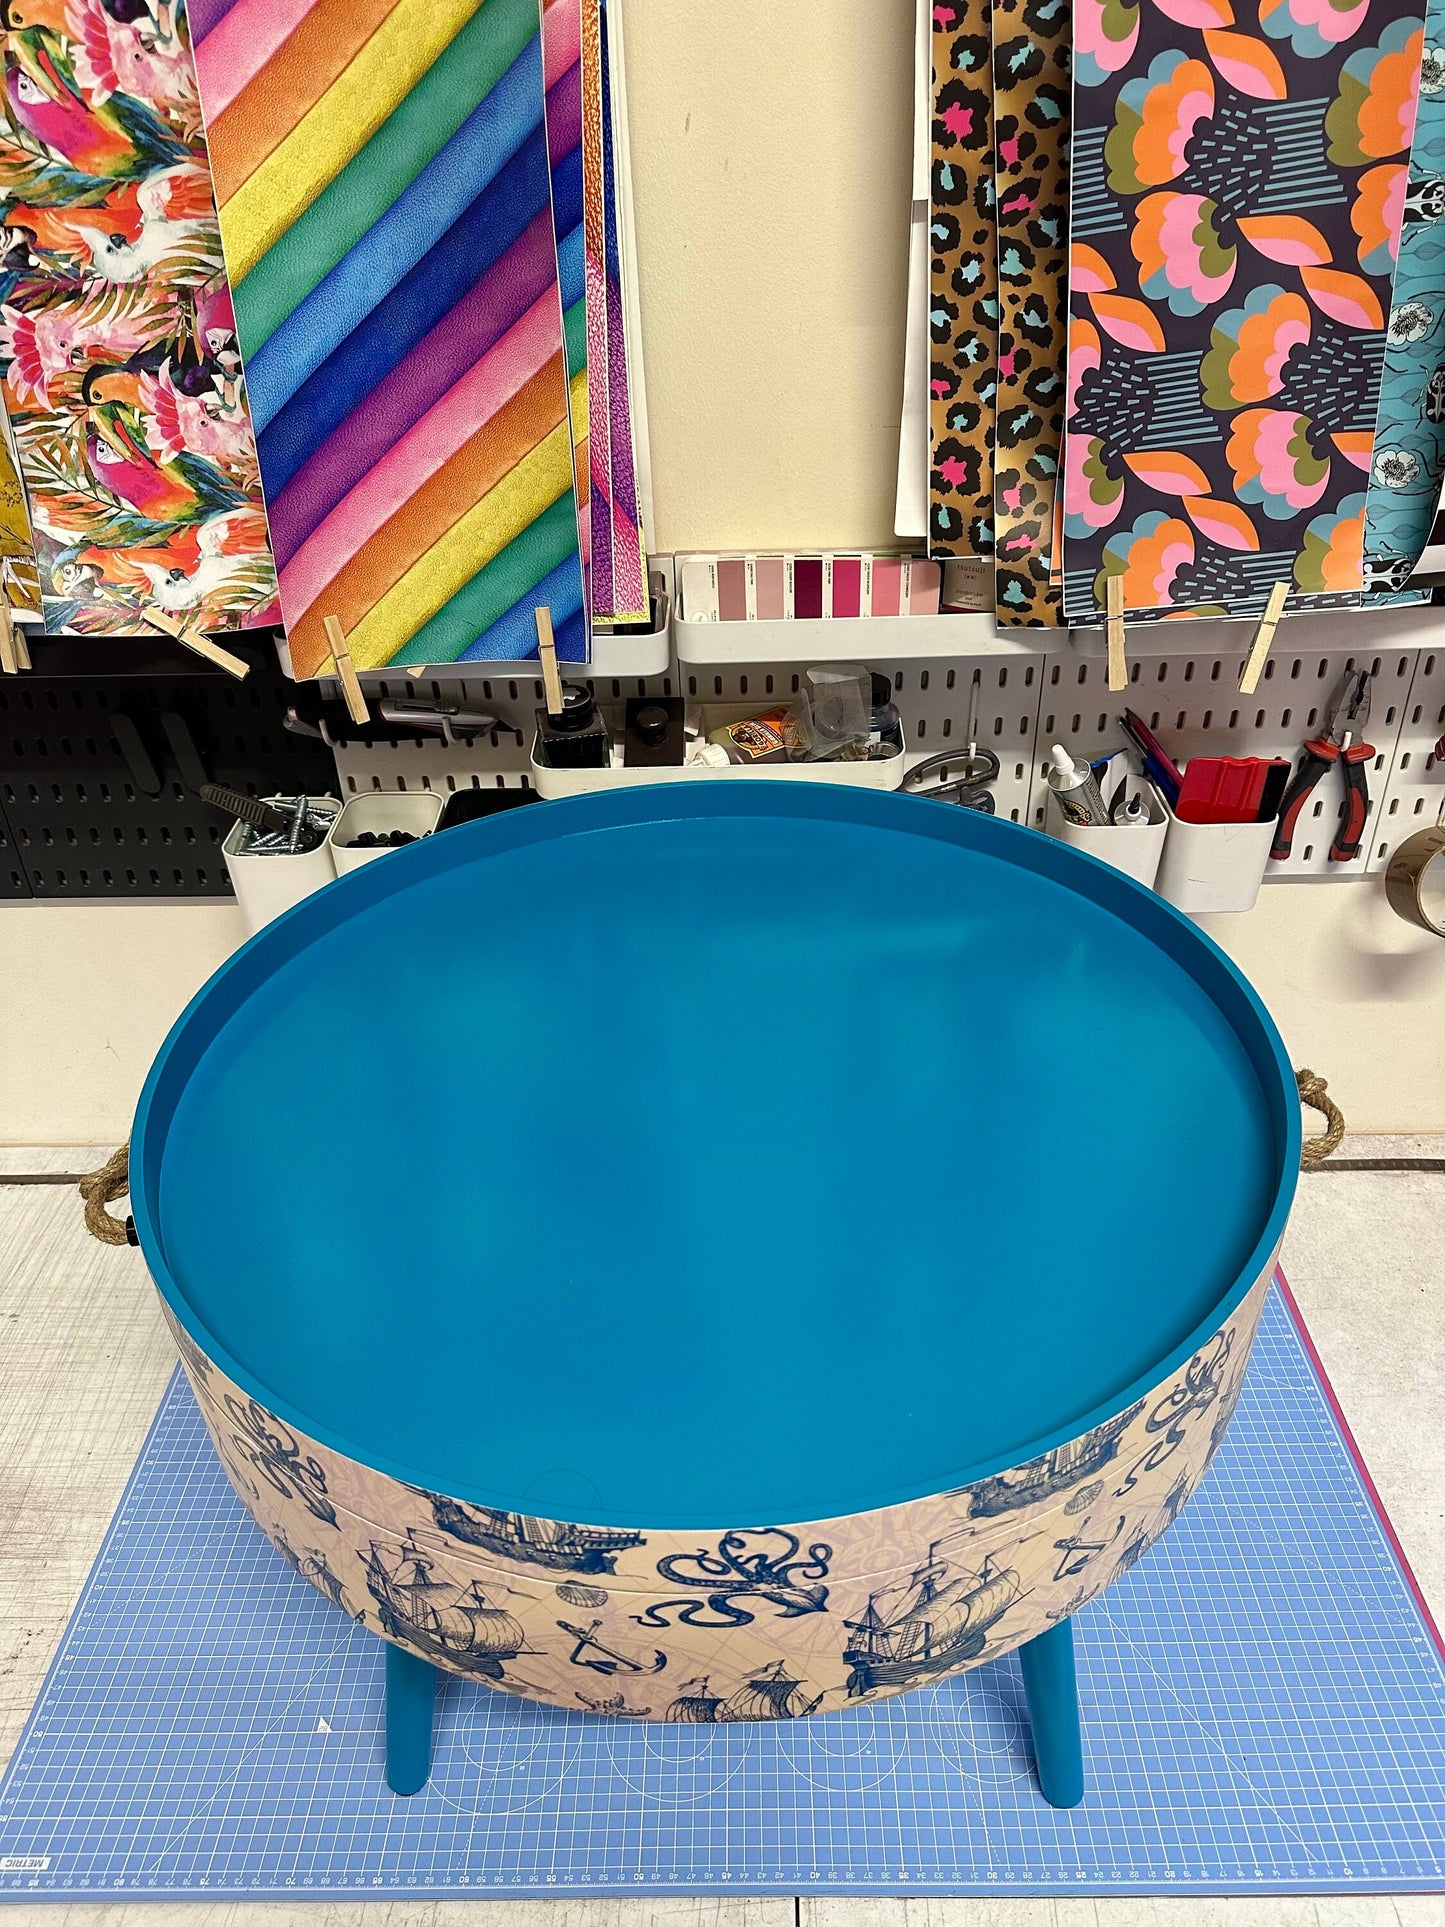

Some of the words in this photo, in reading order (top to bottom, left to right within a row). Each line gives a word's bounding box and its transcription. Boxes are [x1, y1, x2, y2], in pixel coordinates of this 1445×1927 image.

[5, 1859, 44, 1867] METRIC
[721, 1871, 733, 1880] 45
[740, 1871, 750, 1880] 44
[757, 1871, 768, 1880] 43
[775, 1871, 785, 1880] 42
[793, 1871, 803, 1879] 41
[810, 1871, 821, 1879] 40
[828, 1871, 838, 1879] 39
[846, 1871, 856, 1880] 38
[863, 1871, 874, 1880] 37
[881, 1871, 891, 1880] 36
[898, 1871, 910, 1880] 35
[916, 1871, 927, 1880] 34
[934, 1871, 944, 1880] 33
[952, 1871, 962, 1880] 32
[969, 1871, 980, 1880] 31
[987, 1871, 998, 1880] 30
[1005, 1871, 1015, 1880] 29
[1023, 1871, 1033, 1879] 28
[1040, 1871, 1051, 1879] 27
[1058, 1871, 1069, 1879] 26
[1075, 1871, 1087, 1879] 25
[1094, 1870, 1104, 1879] 24
[1111, 1870, 1122, 1879] 23
[1129, 1870, 1140, 1879] 22
[1147, 1870, 1157, 1879] 21
[1164, 1870, 1176, 1878] 20
[1183, 1870, 1193, 1878] 19
[1200, 1870, 1211, 1878] 18
[1218, 1869, 1229, 1878] 17
[1236, 1869, 1246, 1877] 16
[1253, 1869, 1265, 1877] 15
[1272, 1869, 1282, 1877] 14
[1290, 1868, 1300, 1877] 13
[1307, 1868, 1318, 1876] 12
[1325, 1868, 1336, 1876] 11
[1343, 1867, 1354, 1876] 10
[424, 1876, 434, 1884] 62
[441, 1876, 452, 1884] 61
[458, 1876, 470, 1884] 60
[476, 1875, 487, 1884] 59
[494, 1875, 504, 1884] 58
[511, 1875, 522, 1883] 57
[529, 1875, 539, 1883] 56
[546, 1874, 557, 1883] 55
[564, 1874, 574, 1882] 54
[581, 1874, 592, 1882] 53
[599, 1873, 609, 1882] 52
[616, 1873, 627, 1881] 51
[633, 1872, 645, 1881] 50
[652, 1872, 662, 1881] 49
[669, 1872, 680, 1880] 48
[687, 1872, 697, 1880] 47
[704, 1872, 715, 1880] 46
[113, 1878, 124, 1887] 80
[131, 1878, 141, 1887] 79
[148, 1878, 158, 1887] 78
[165, 1878, 175, 1886] 77
[182, 1878, 192, 1886] 76
[198, 1878, 210, 1886] 75
[216, 1878, 227, 1886] 74
[233, 1878, 244, 1886] 73
[251, 1877, 261, 1886] 72
[268, 1877, 278, 1886] 71
[285, 1877, 296, 1886] 70
[302, 1877, 313, 1885] 69
[320, 1877, 330, 1885] 68
[337, 1877, 347, 1885] 67
[354, 1877, 365, 1885] 66
[371, 1876, 383, 1885] 65
[389, 1876, 400, 1885] 64
[406, 1876, 417, 1885] 63
